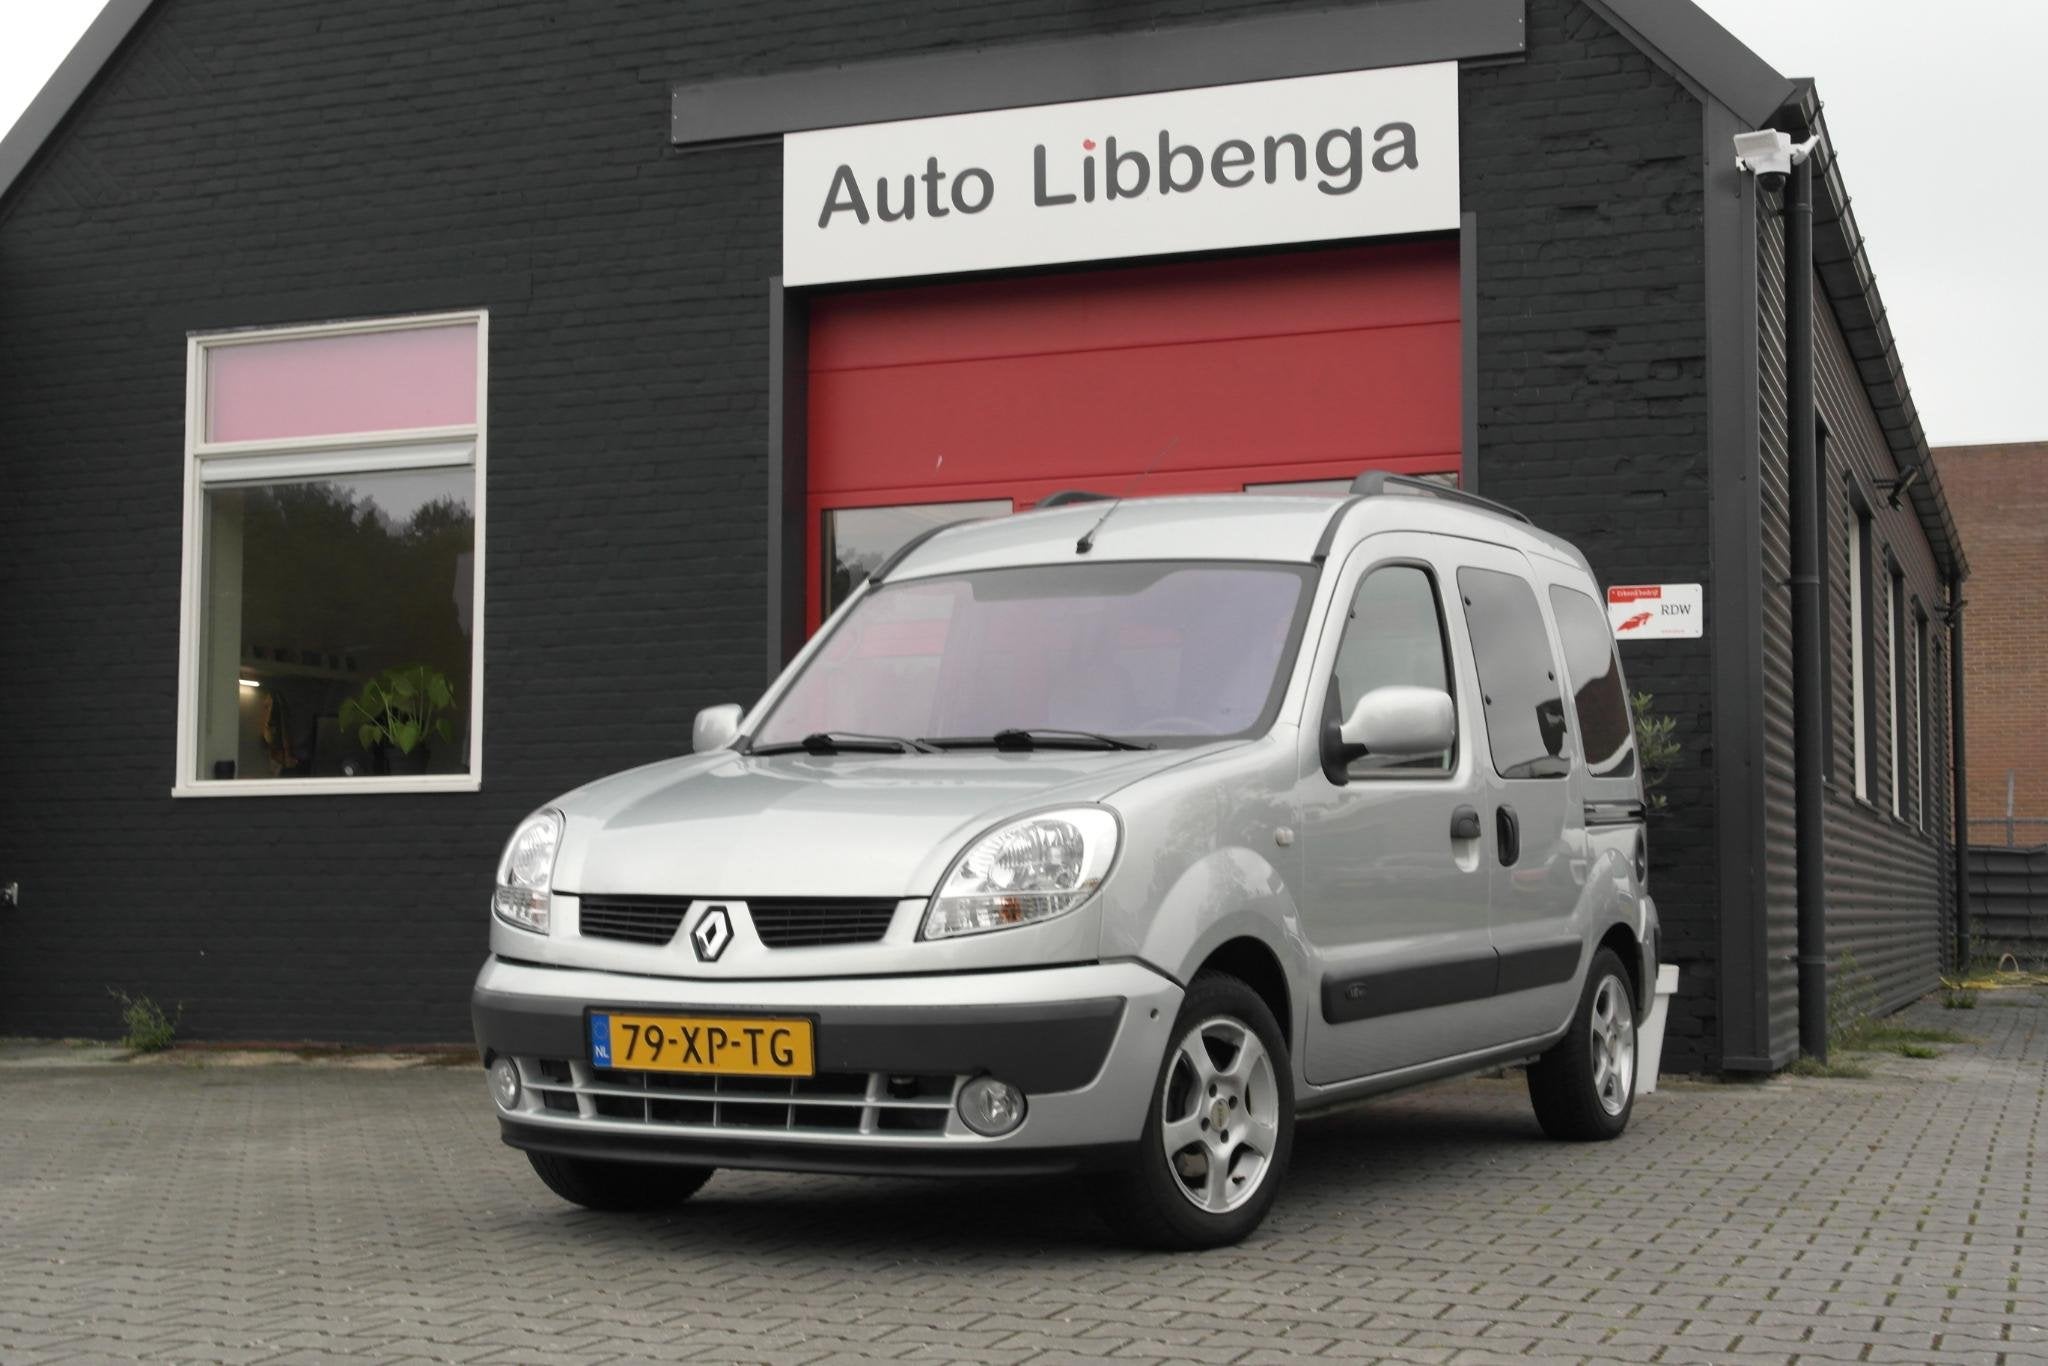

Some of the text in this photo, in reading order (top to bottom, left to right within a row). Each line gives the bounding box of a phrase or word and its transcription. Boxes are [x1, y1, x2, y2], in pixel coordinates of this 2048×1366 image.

[818, 121, 1419, 229] Auto Libbenga
[1661, 604, 1691, 615] RDW
[595, 1023, 794, 1067] NL 79-XP-TG
